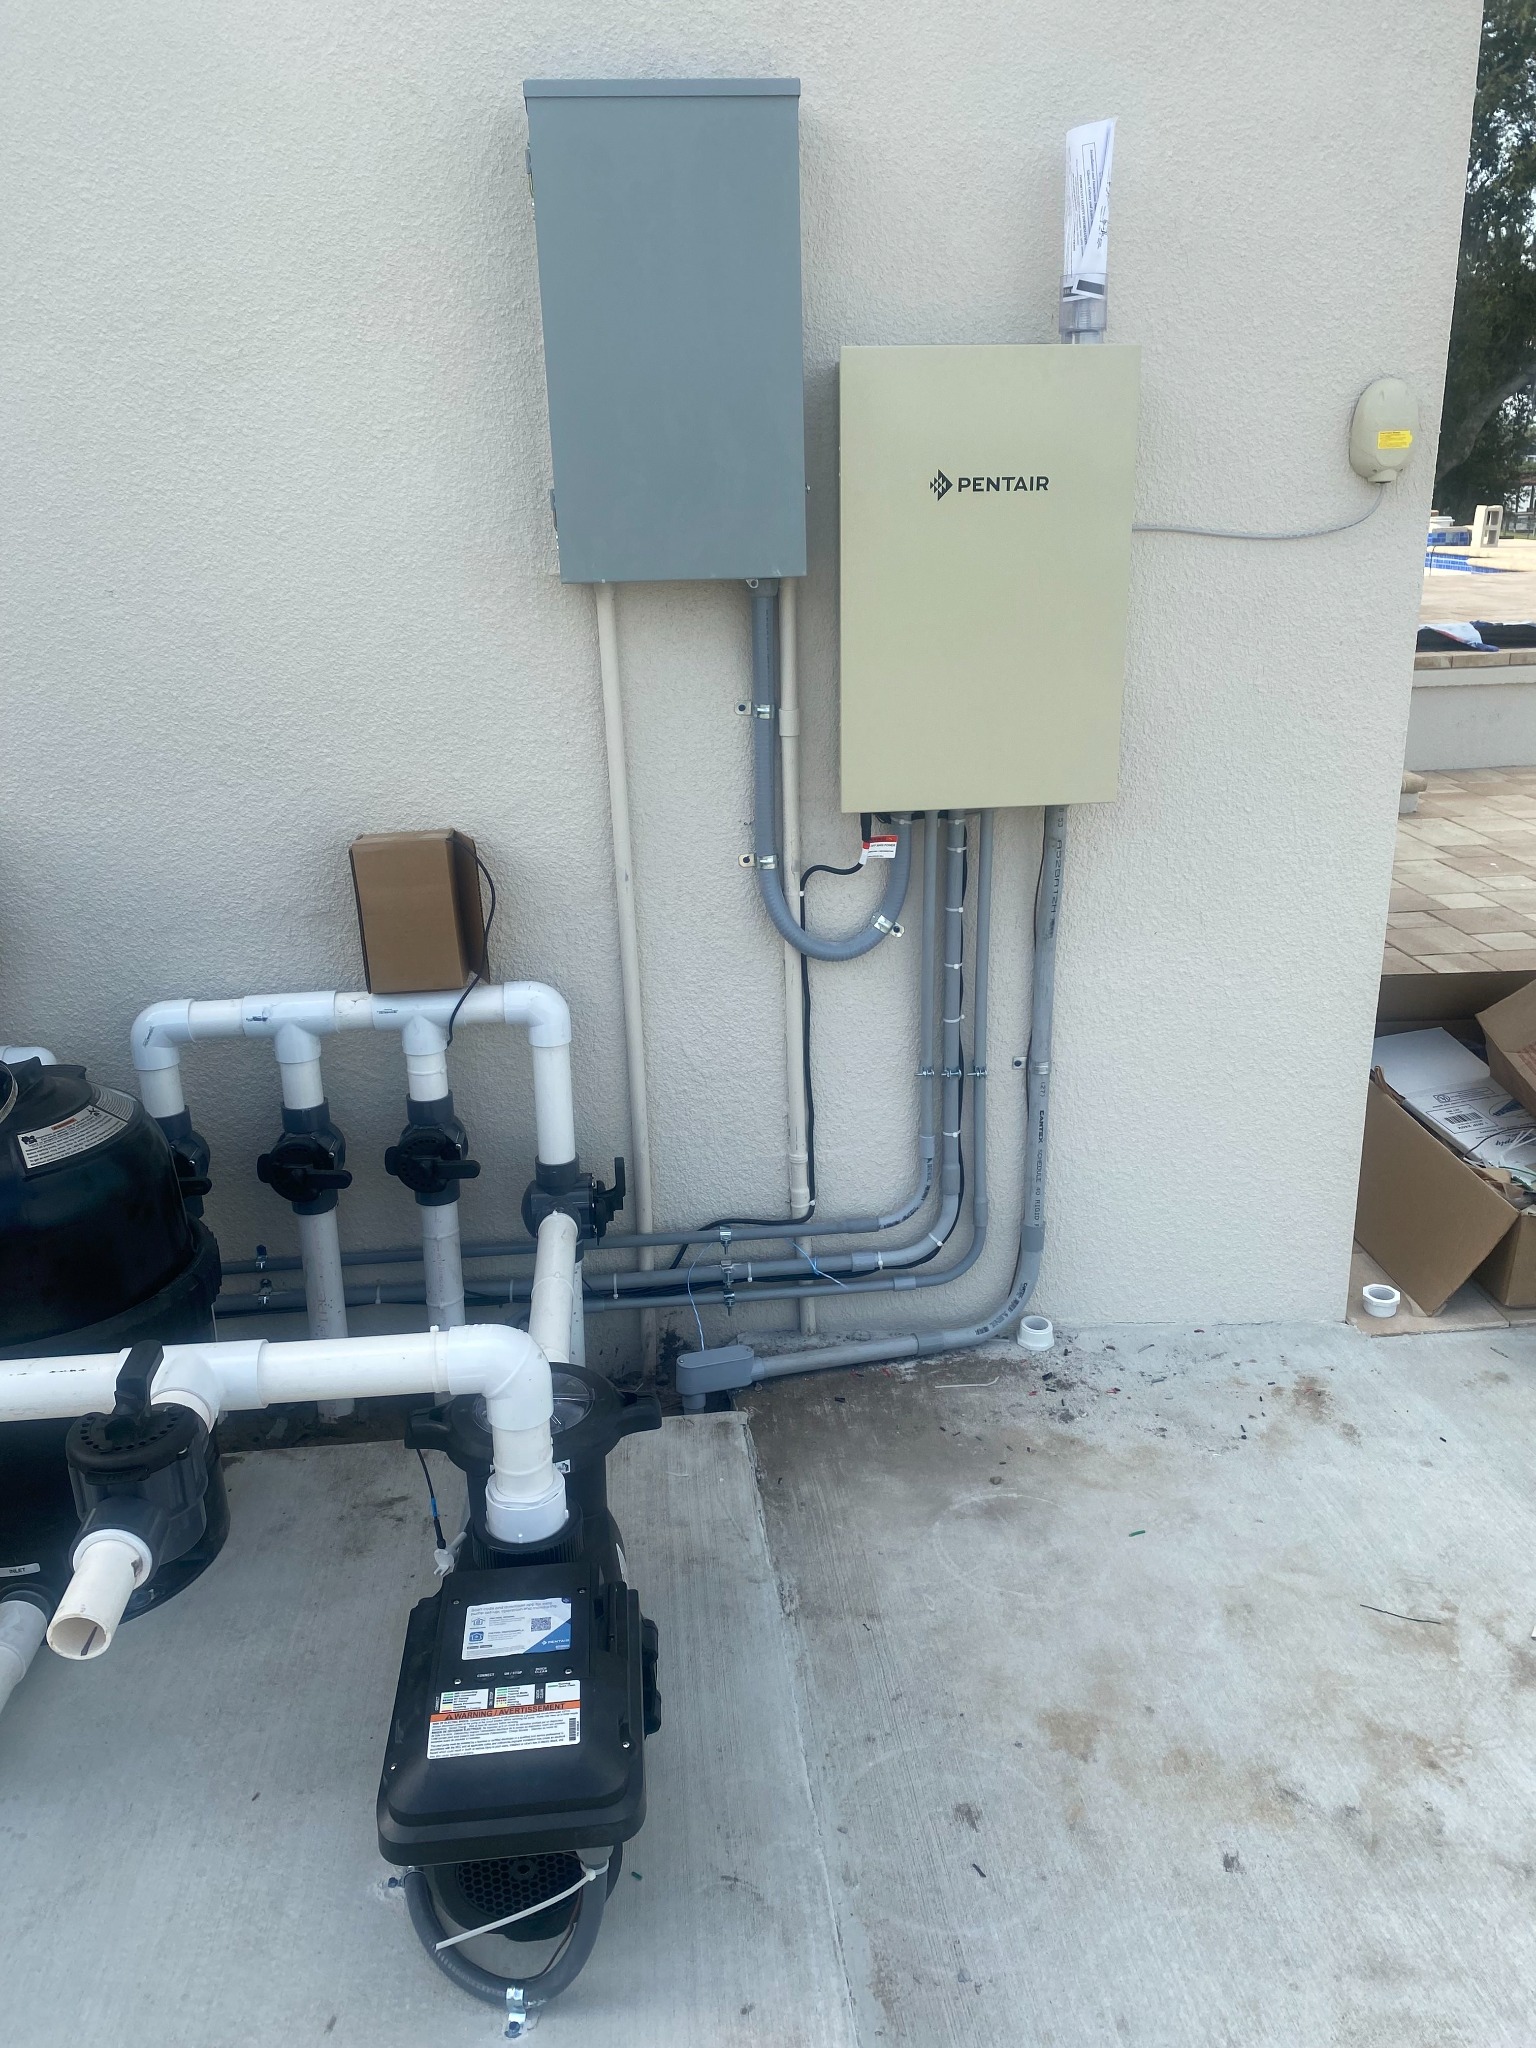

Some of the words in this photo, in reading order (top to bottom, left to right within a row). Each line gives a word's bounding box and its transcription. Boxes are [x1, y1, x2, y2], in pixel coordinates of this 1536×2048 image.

[958, 476, 1050, 492] PENTAIR
[454, 1710, 493, 1720] WARNING
[499, 1703, 565, 1716] AVERTISSEMENT
